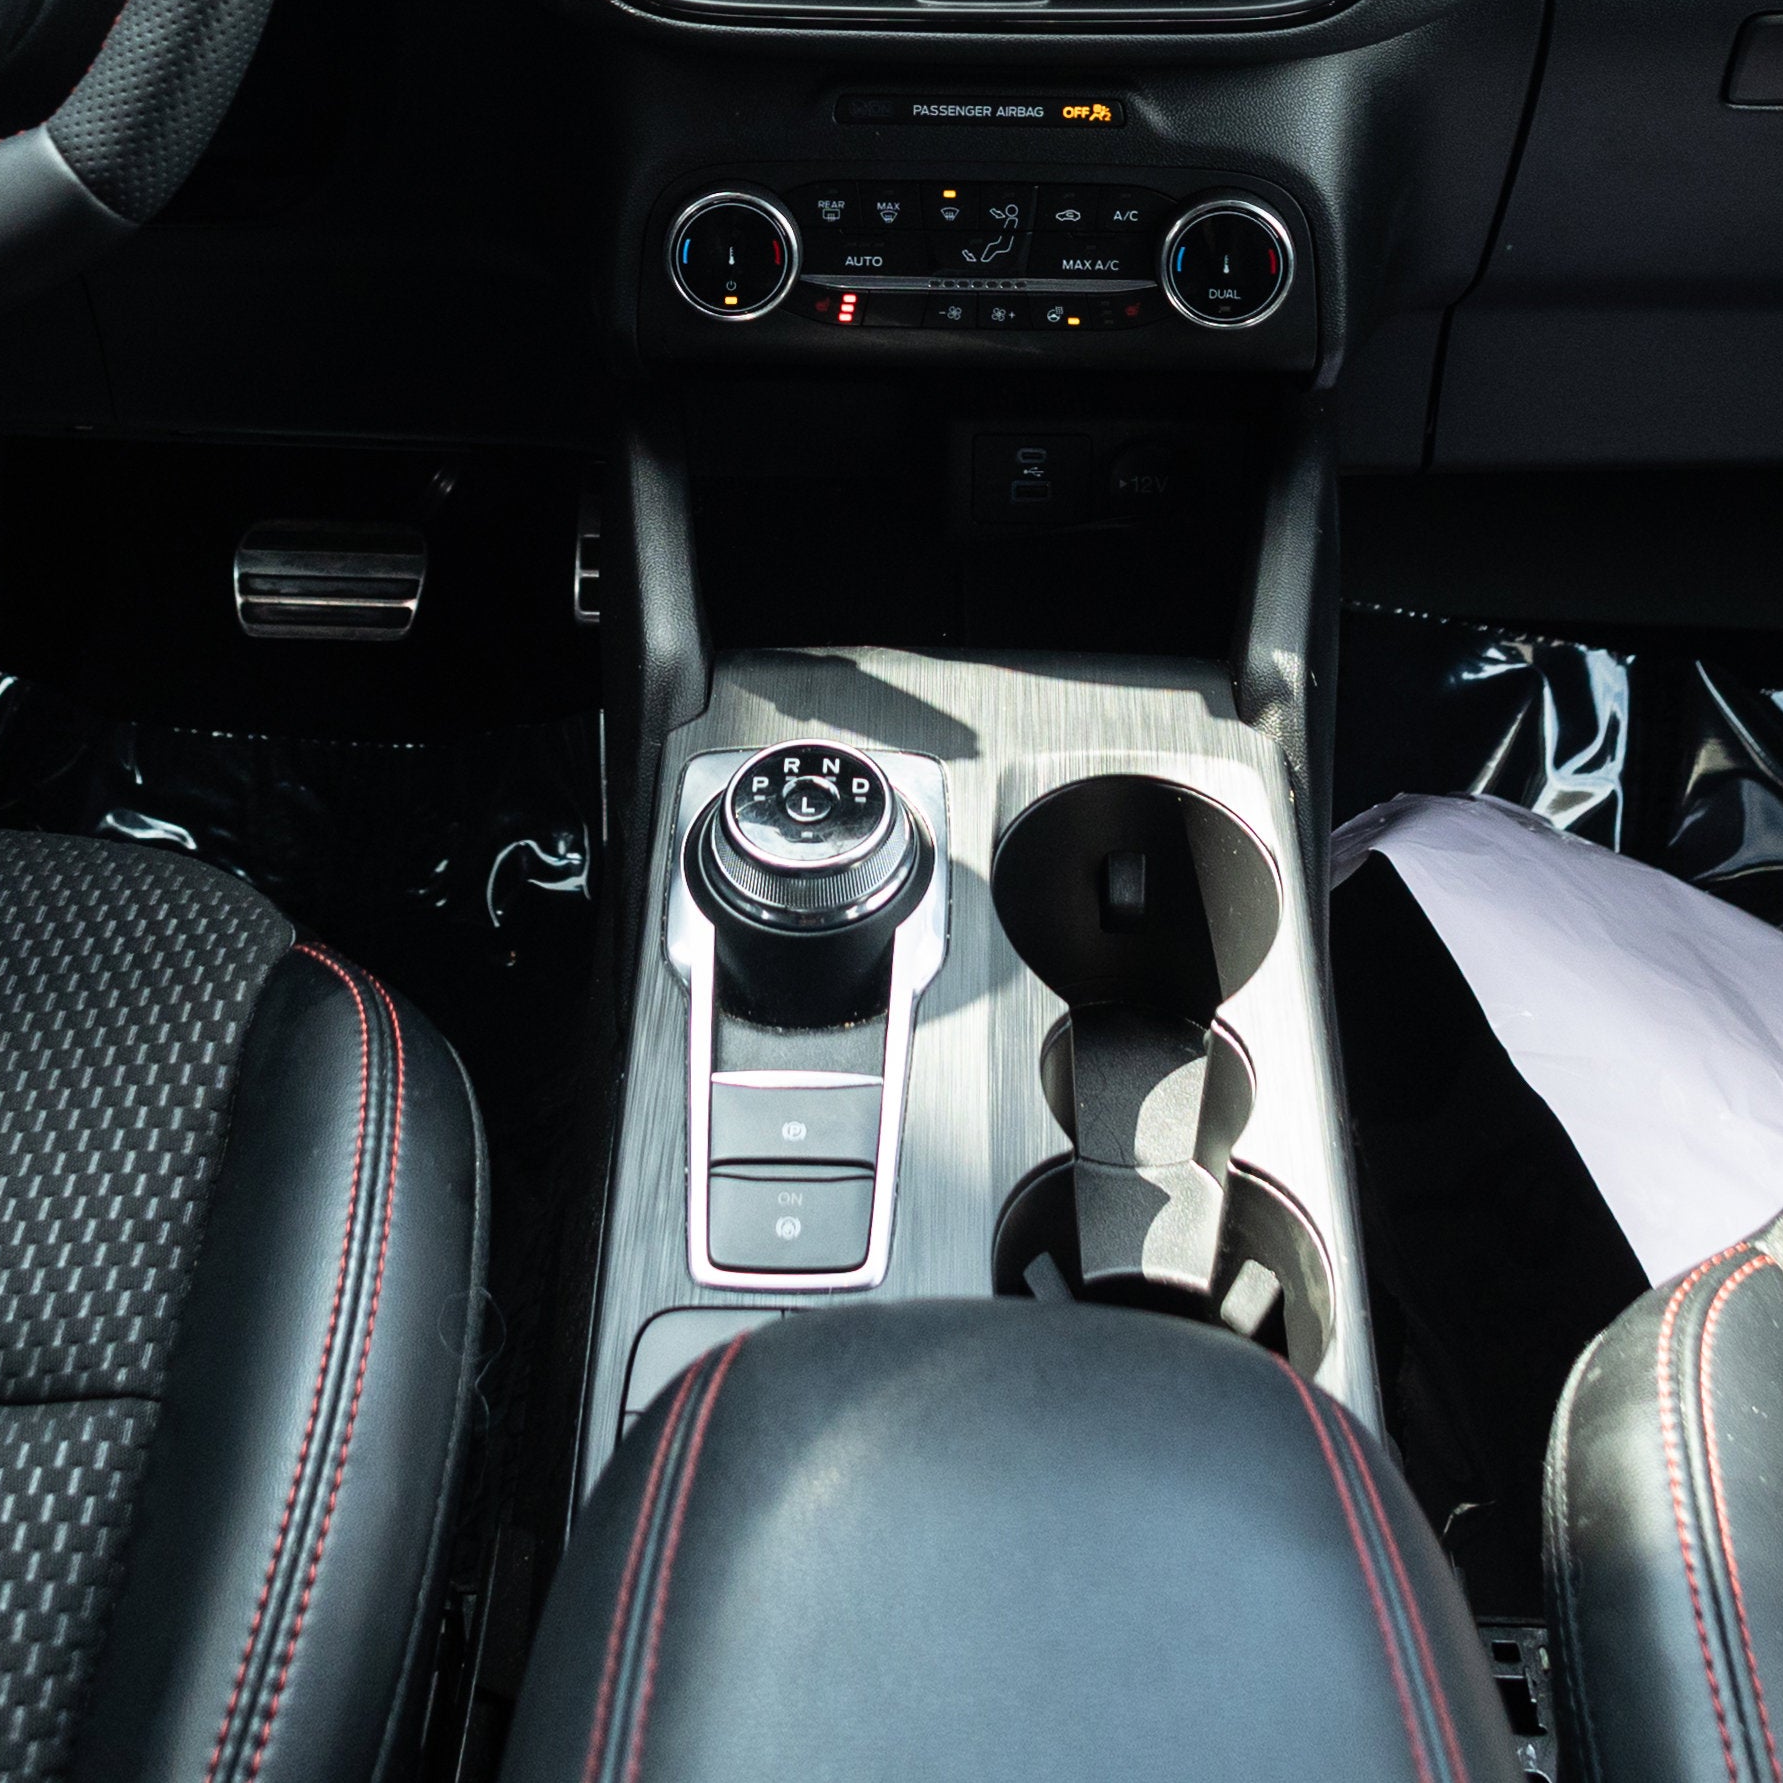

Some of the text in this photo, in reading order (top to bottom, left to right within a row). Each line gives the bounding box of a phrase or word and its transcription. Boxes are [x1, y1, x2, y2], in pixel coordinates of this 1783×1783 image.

[913, 104, 1045, 118] PASSENGER AIRBAG
[1062, 106, 1090, 120] OFF
[817, 200, 845, 210] REAR
[877, 201, 901, 211] MAX
[1113, 210, 1139, 222] A/C
[845, 256, 883, 267] AUTO
[1062, 259, 1120, 272] MAX A/C
[1208, 288, 1241, 300] DUAL
[751, 757, 870, 794] P R N D
[802, 797, 815, 814] L
[778, 1191, 803, 1207] ON
